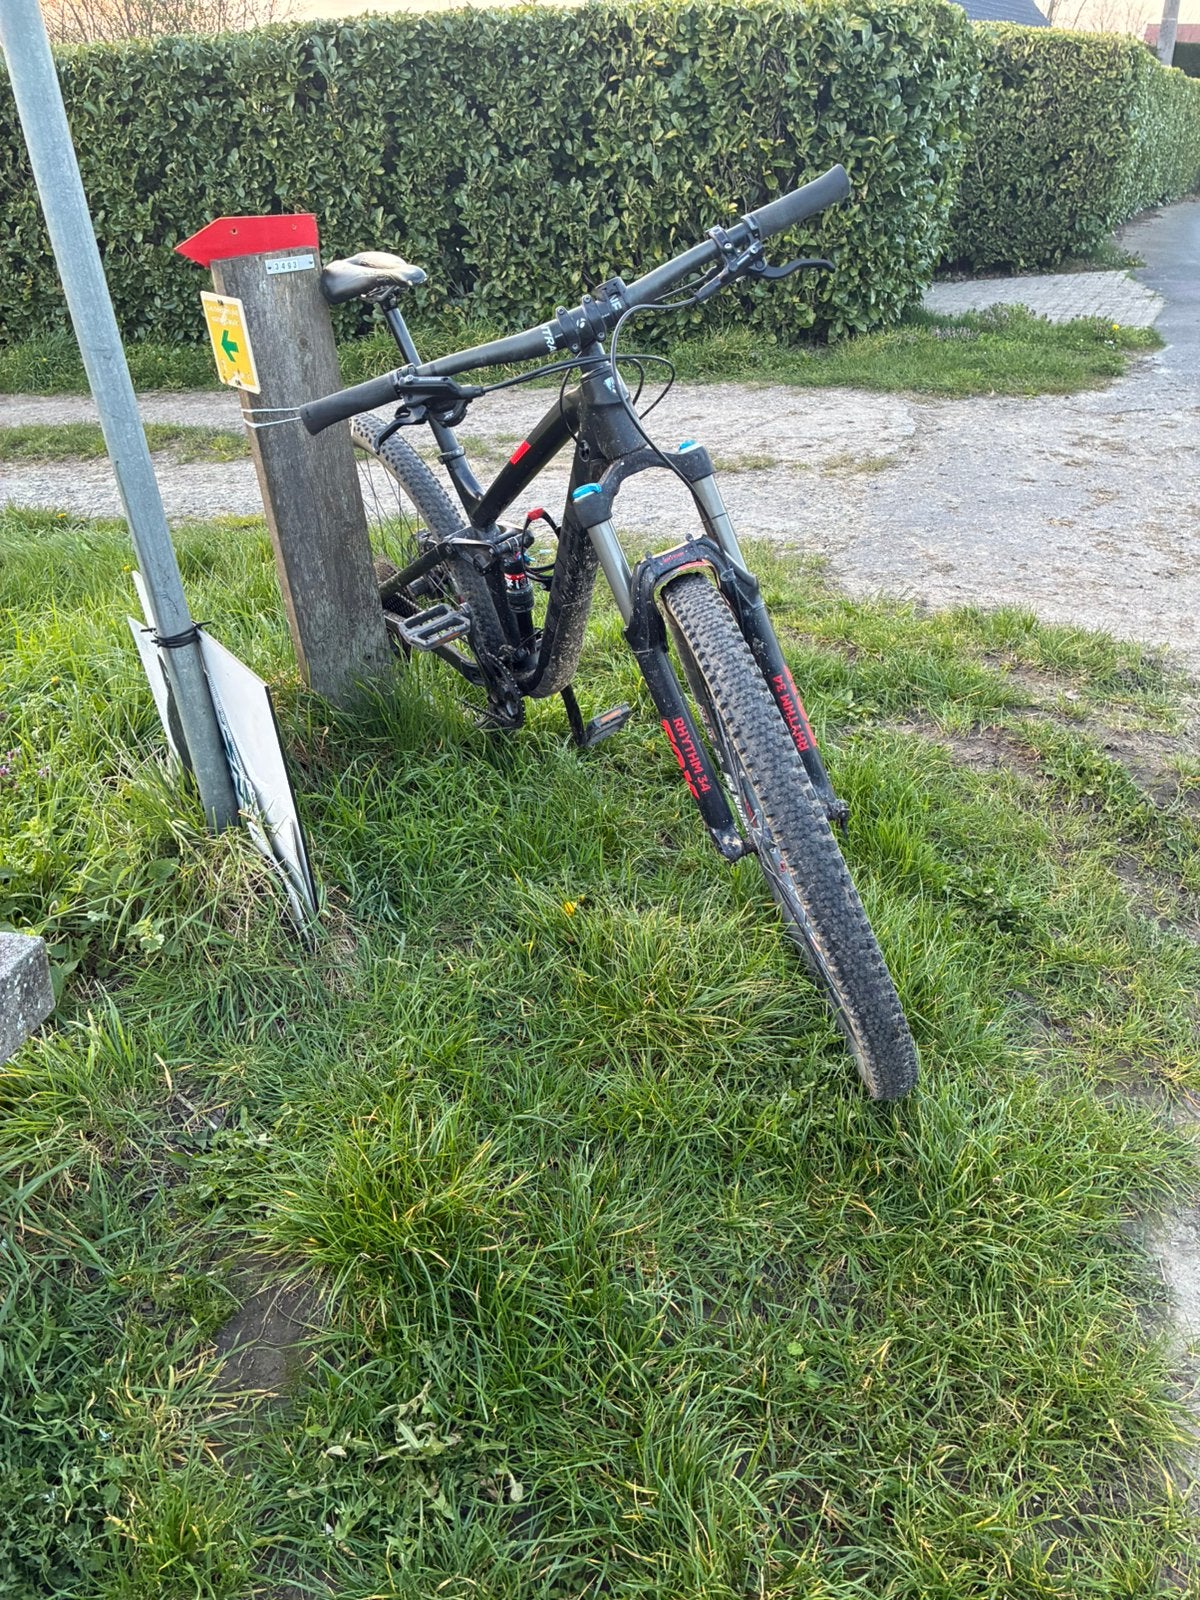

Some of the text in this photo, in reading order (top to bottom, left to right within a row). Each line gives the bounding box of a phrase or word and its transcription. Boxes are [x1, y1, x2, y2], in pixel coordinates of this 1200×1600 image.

[772, 674, 787, 693] 34
[780, 694, 809, 752] RHYTHM
[673, 717, 704, 774] RHYTHM
[697, 774, 711, 793] 34
